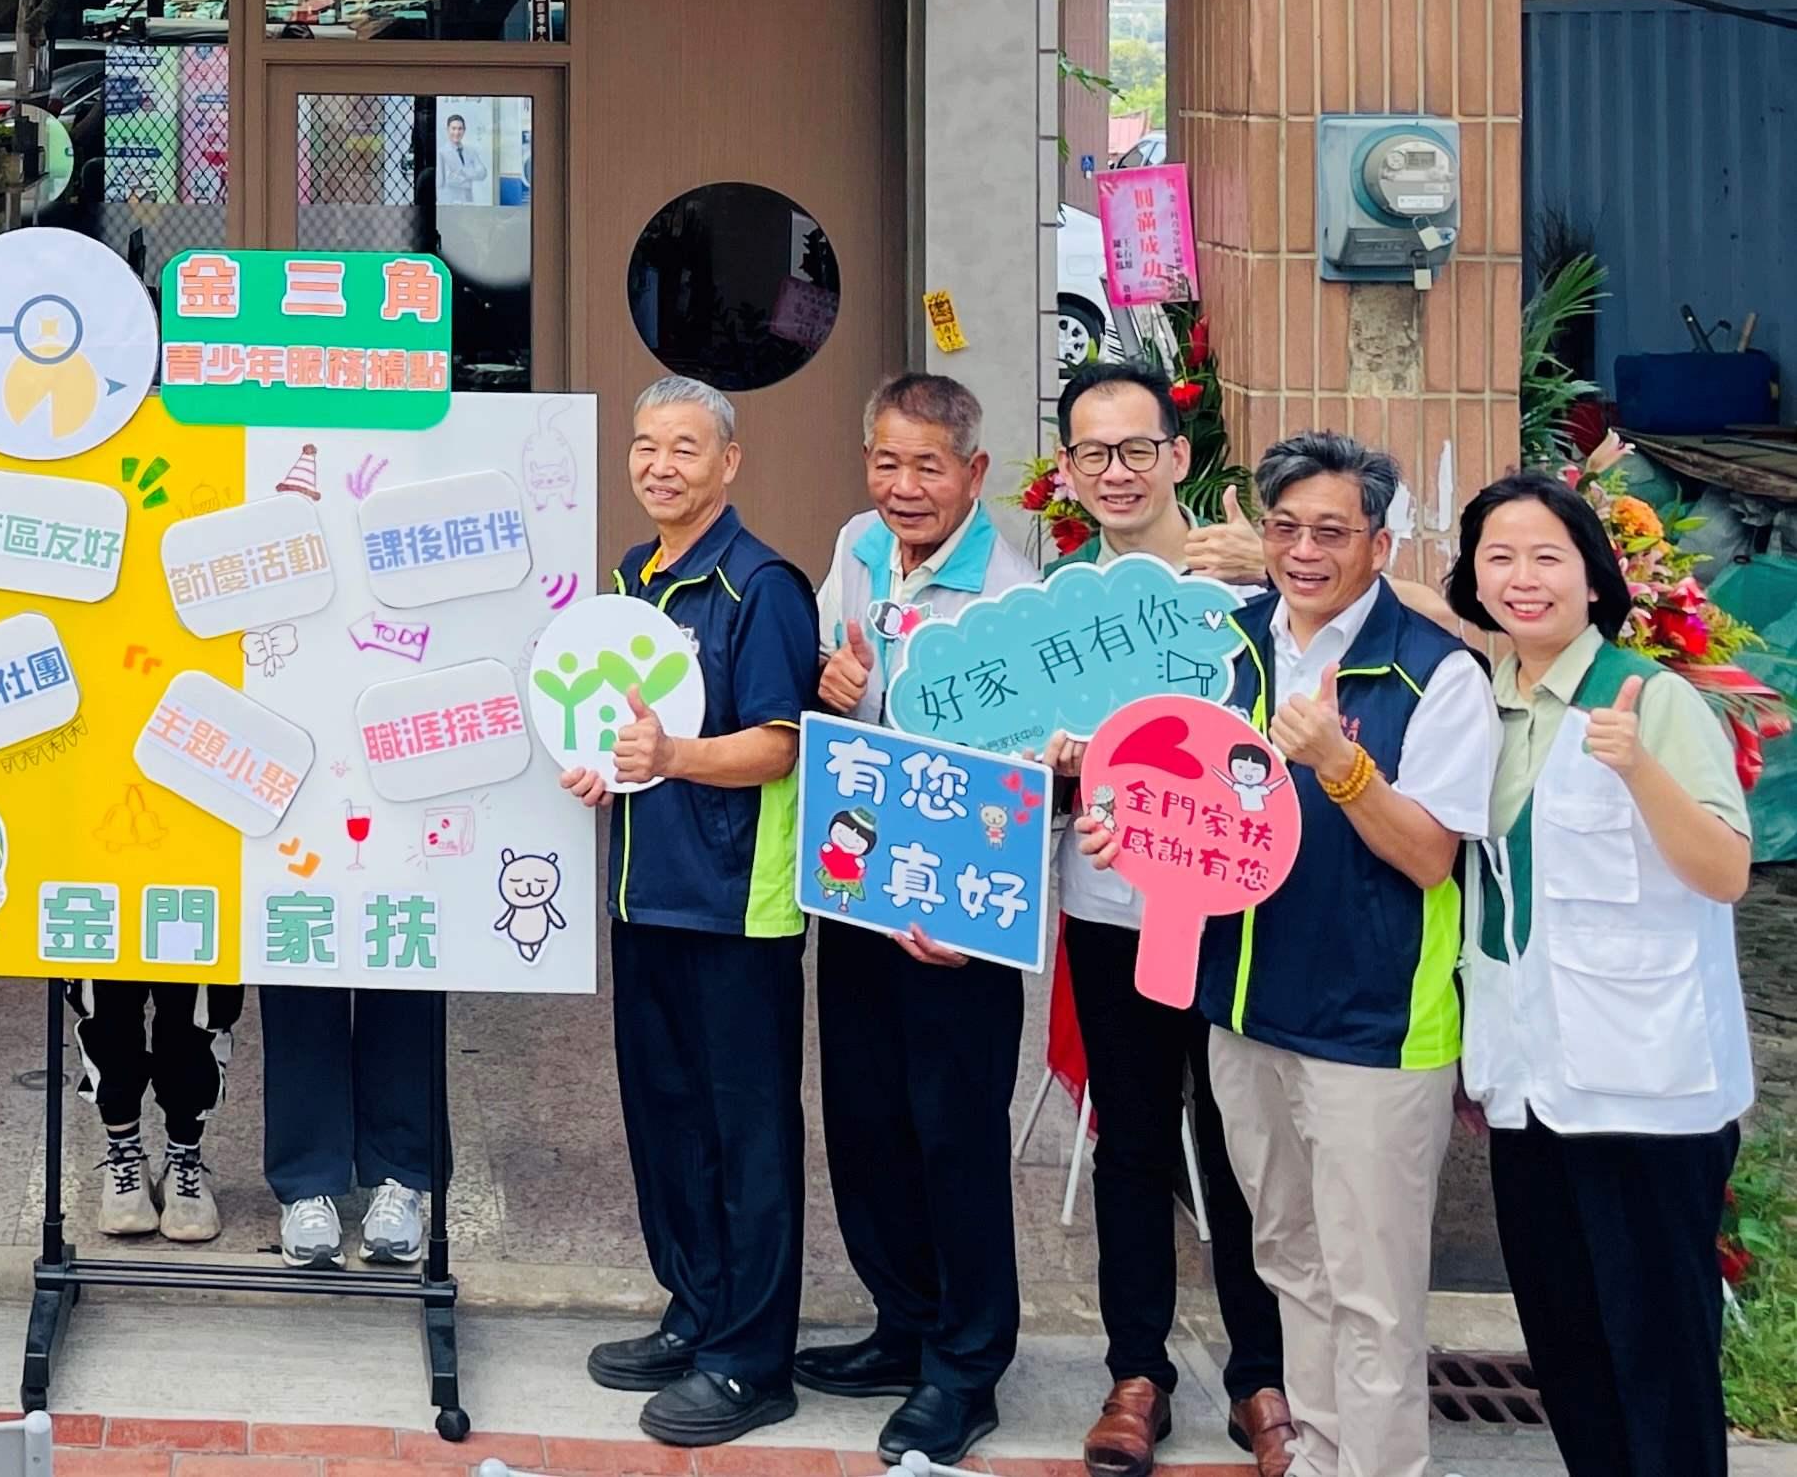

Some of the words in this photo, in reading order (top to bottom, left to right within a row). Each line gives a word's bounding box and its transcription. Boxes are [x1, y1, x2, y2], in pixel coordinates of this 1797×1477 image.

[179, 256, 441, 320] 金三角
[165, 344, 447, 390] 青少年服務據點
[169, 533, 327, 606] 節慶活動
[364, 510, 524, 571] 課後陪伴
[373, 623, 396, 642] TO
[917, 658, 1019, 731] 好家
[1032, 594, 1190, 686] 再有你
[147, 703, 300, 810] 主題小聚
[361, 693, 524, 765] 職涯探索
[826, 736, 969, 820] 有您
[1125, 780, 1273, 853] 金門家扶
[882, 842, 1029, 929] 真好
[1122, 825, 1269, 892] 感謝有您
[43, 886, 437, 970] 金門家扶
